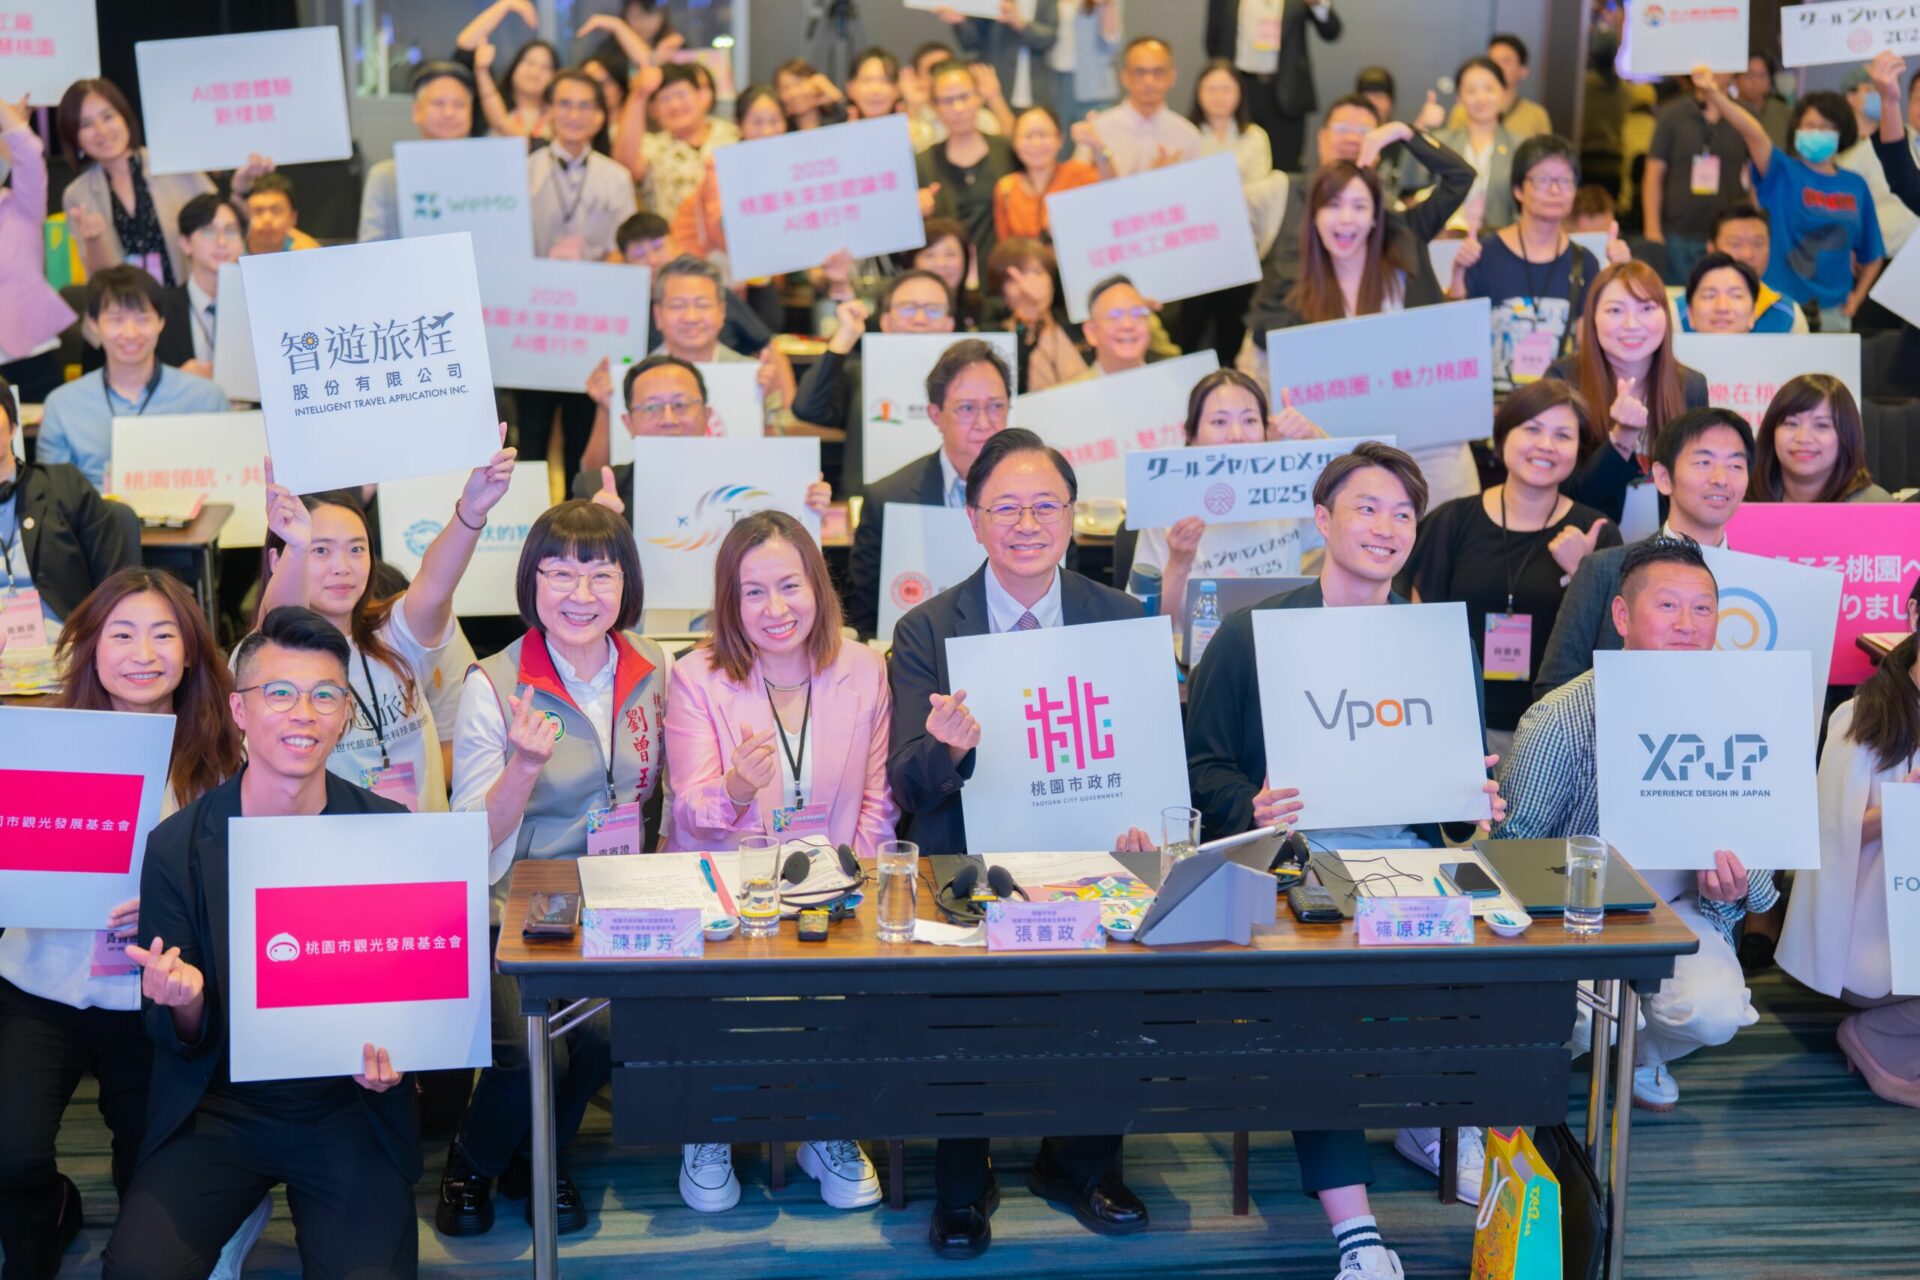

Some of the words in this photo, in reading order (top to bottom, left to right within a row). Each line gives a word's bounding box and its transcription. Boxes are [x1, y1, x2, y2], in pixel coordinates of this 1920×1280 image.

[281, 313, 455, 375] 智遊旅程
[293, 363, 462, 400] 股份有限公司
[294, 401, 352, 417] INTELLIGENT
[354, 396, 387, 409] TRAVEL
[389, 388, 448, 404] APPLICATION
[449, 385, 470, 395] INC.
[1248, 484, 1306, 506] 2025
[1304, 689, 1433, 741] Vpon
[1031, 772, 1122, 797] 桃園市政府
[1640, 789, 1694, 798] EXPERIENCE
[1696, 789, 1728, 798] DESIGN
[1730, 789, 1739, 798] IN
[1741, 789, 1771, 798] JAPAN
[1032, 799, 1061, 808] TAOYUAN
[1064, 796, 1078, 804] CITY
[1080, 791, 1123, 802] GOVERNMENT
[0, 815, 130, 832] 市觀光發展基金會
[1015, 925, 1075, 943] 張善政
[1375, 920, 1455, 938] 篠原好孝
[305, 935, 462, 955] 桃園市觀光發展基金會
[612, 933, 673, 951] 陳靜芳
